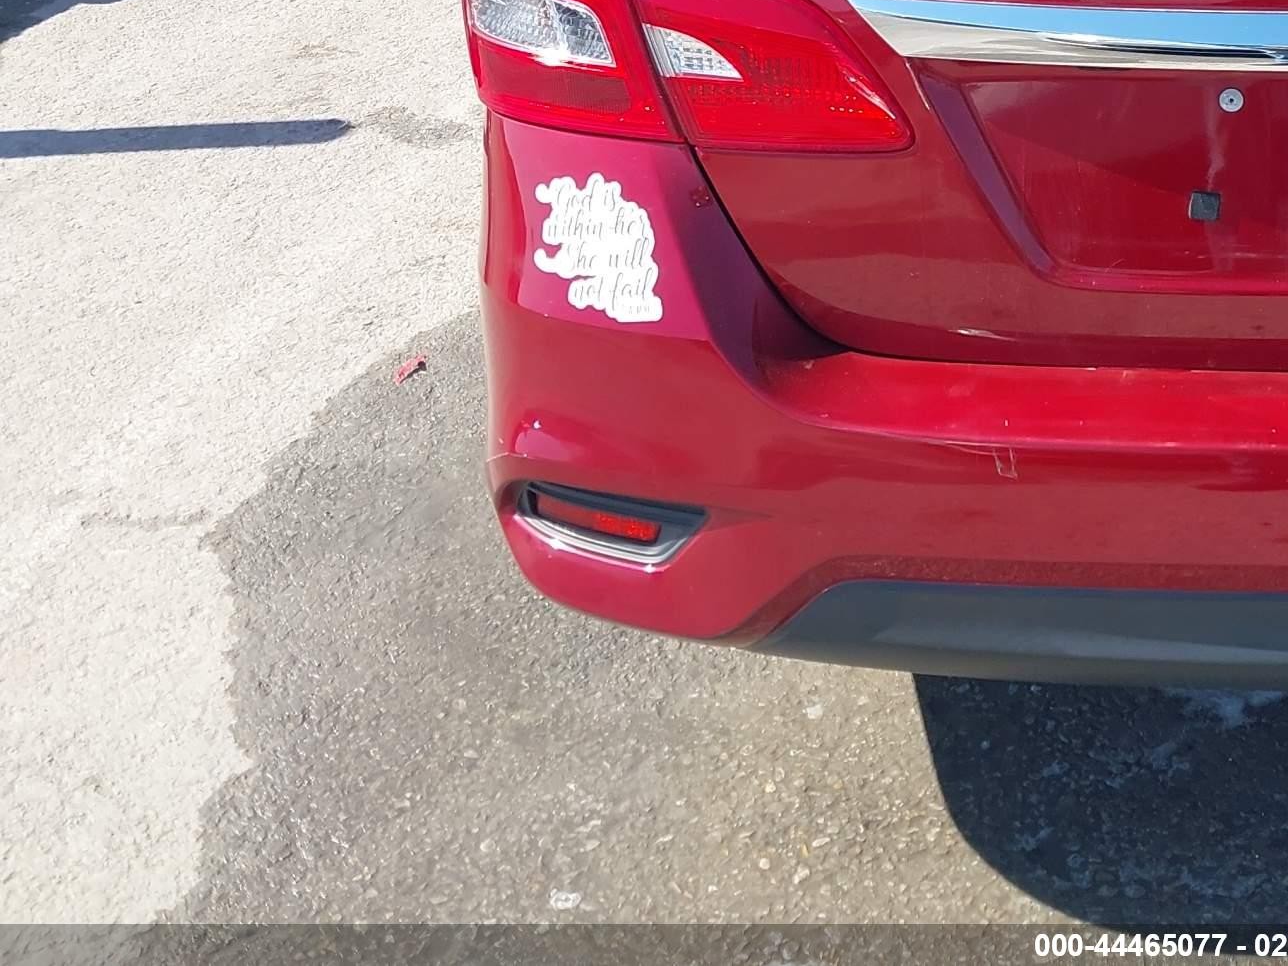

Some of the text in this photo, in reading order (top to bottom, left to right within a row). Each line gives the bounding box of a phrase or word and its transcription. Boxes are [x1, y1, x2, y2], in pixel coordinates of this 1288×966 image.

[603, 186, 617, 212] is
[547, 209, 604, 241] within
[608, 237, 650, 270] will
[609, 267, 653, 312] fail
